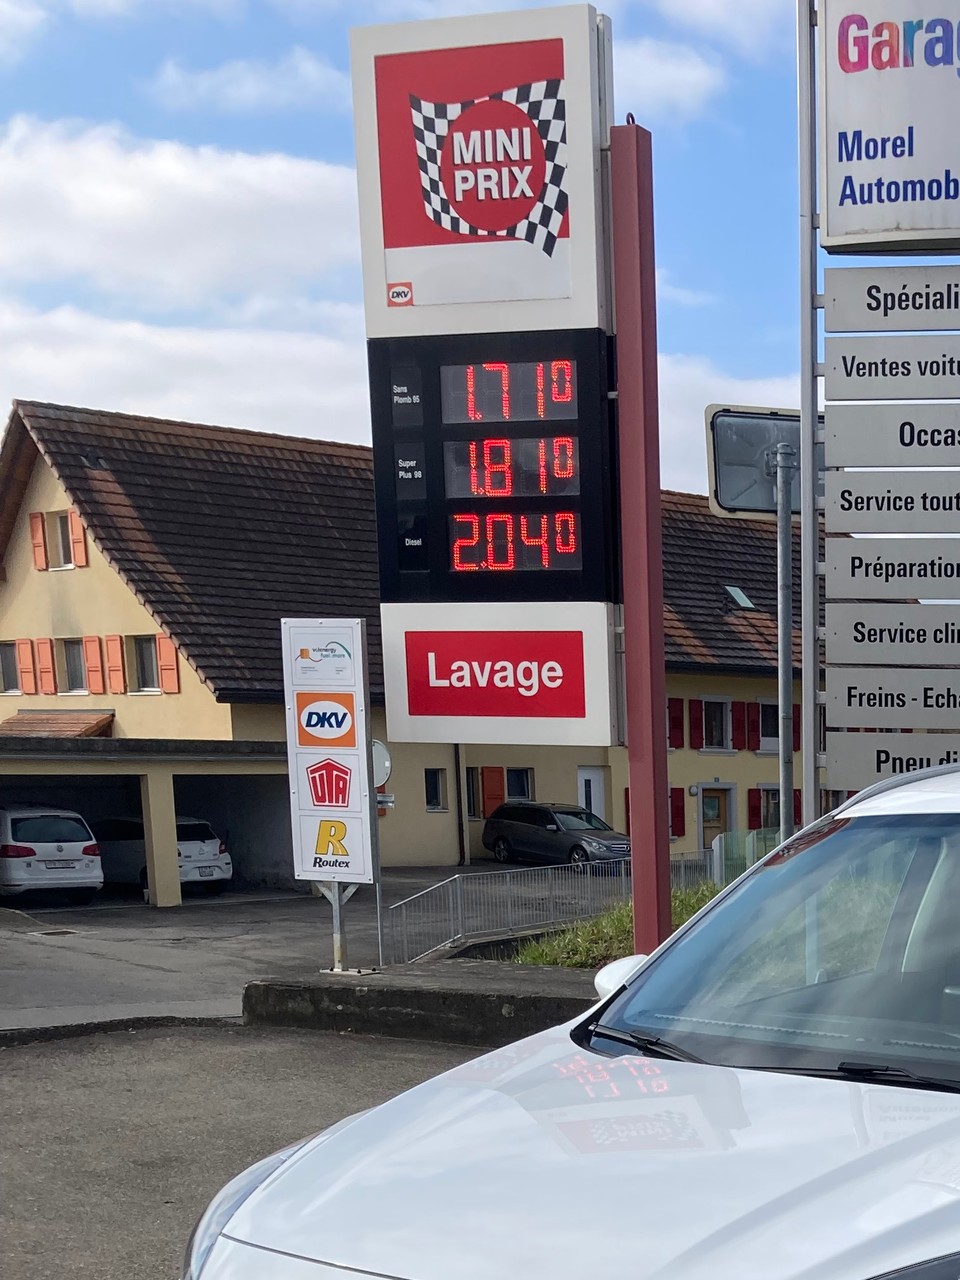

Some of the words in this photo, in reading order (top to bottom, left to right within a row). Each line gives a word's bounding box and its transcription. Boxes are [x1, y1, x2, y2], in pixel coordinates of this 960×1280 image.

[453, 127, 532, 165] MINI
[838, 126, 914, 162] Morel
[454, 165, 534, 202] PRIX
[391, 290, 409, 299] DKV
[842, 355, 911, 377] Ventes
[398, 459, 416, 468] Super
[398, 470, 412, 479] Plus
[840, 489, 914, 512] Service
[405, 538, 422, 546] Diesel
[853, 621, 927, 644] Service
[427, 652, 563, 697] Lavage
[847, 686, 906, 708] Freins
[305, 711, 348, 728] DKV
[876, 749, 931, 773] Pneu
[308, 760, 351, 805] UTA
[315, 820, 349, 856] R
[313, 857, 350, 868] Routex
